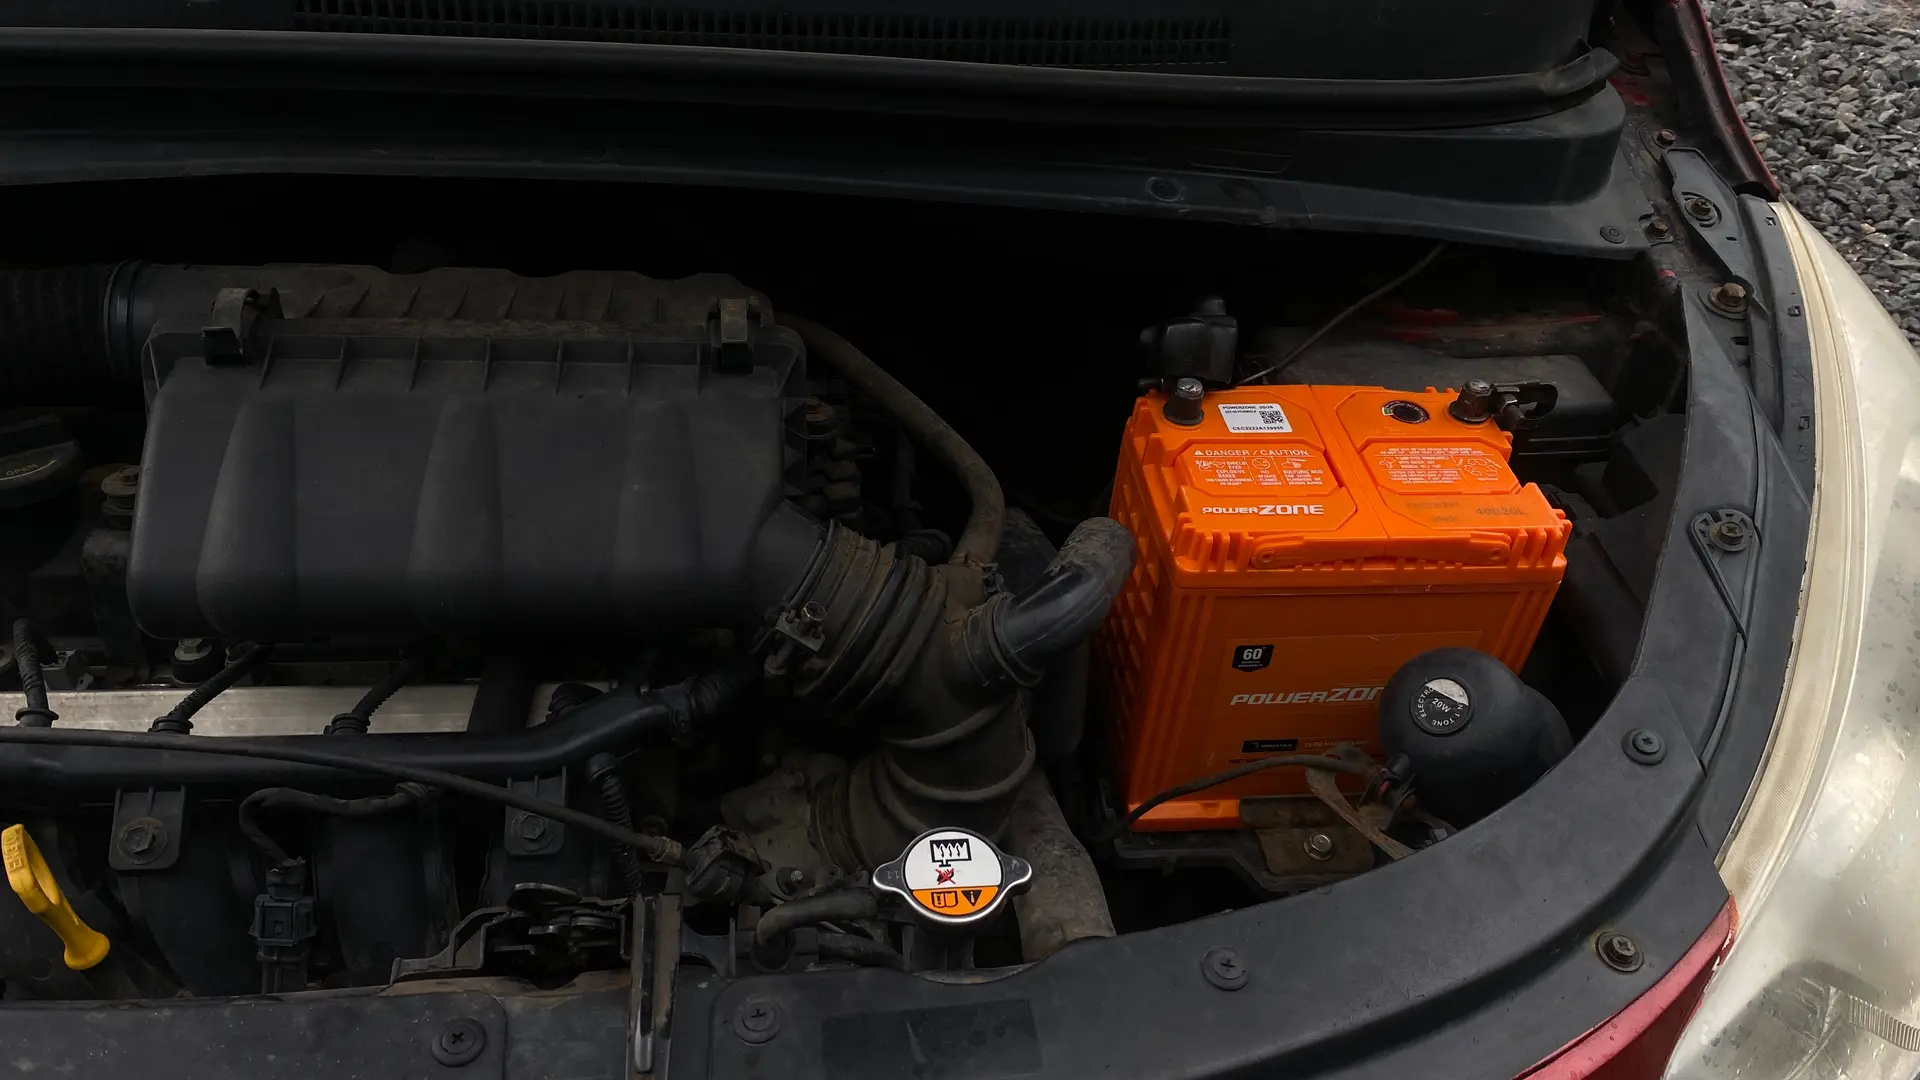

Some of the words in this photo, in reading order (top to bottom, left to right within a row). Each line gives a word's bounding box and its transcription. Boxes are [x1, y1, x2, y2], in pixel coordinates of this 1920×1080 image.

[6, 464, 38, 475] OPEN
[1202, 504, 1324, 515] POWERZONE
[1230, 686, 1385, 706] POWERZO
[1417, 686, 1434, 718] ELECTRO
[1432, 718, 1455, 727] TONE
[1432, 698, 1452, 713] 20W
